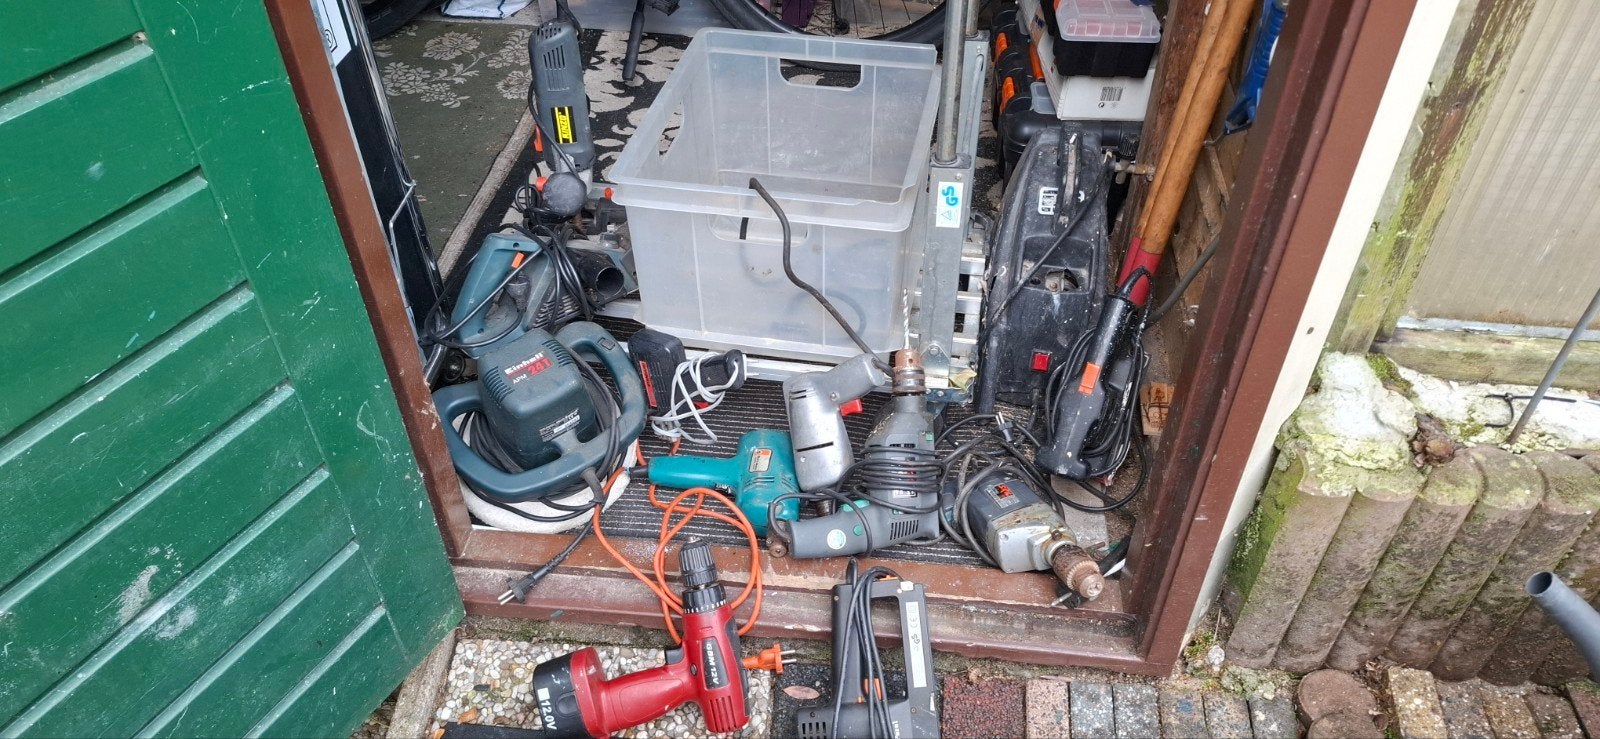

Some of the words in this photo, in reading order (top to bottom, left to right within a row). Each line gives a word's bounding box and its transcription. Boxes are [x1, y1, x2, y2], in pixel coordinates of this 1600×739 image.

[941, 185, 958, 206] GS
[504, 350, 544, 374] Einhell
[512, 373, 527, 384] APM
[528, 357, 553, 376] 241
[911, 633, 920, 644] GS
[710, 667, 719, 685] 12V
[541, 700, 557, 730] 12.0V
